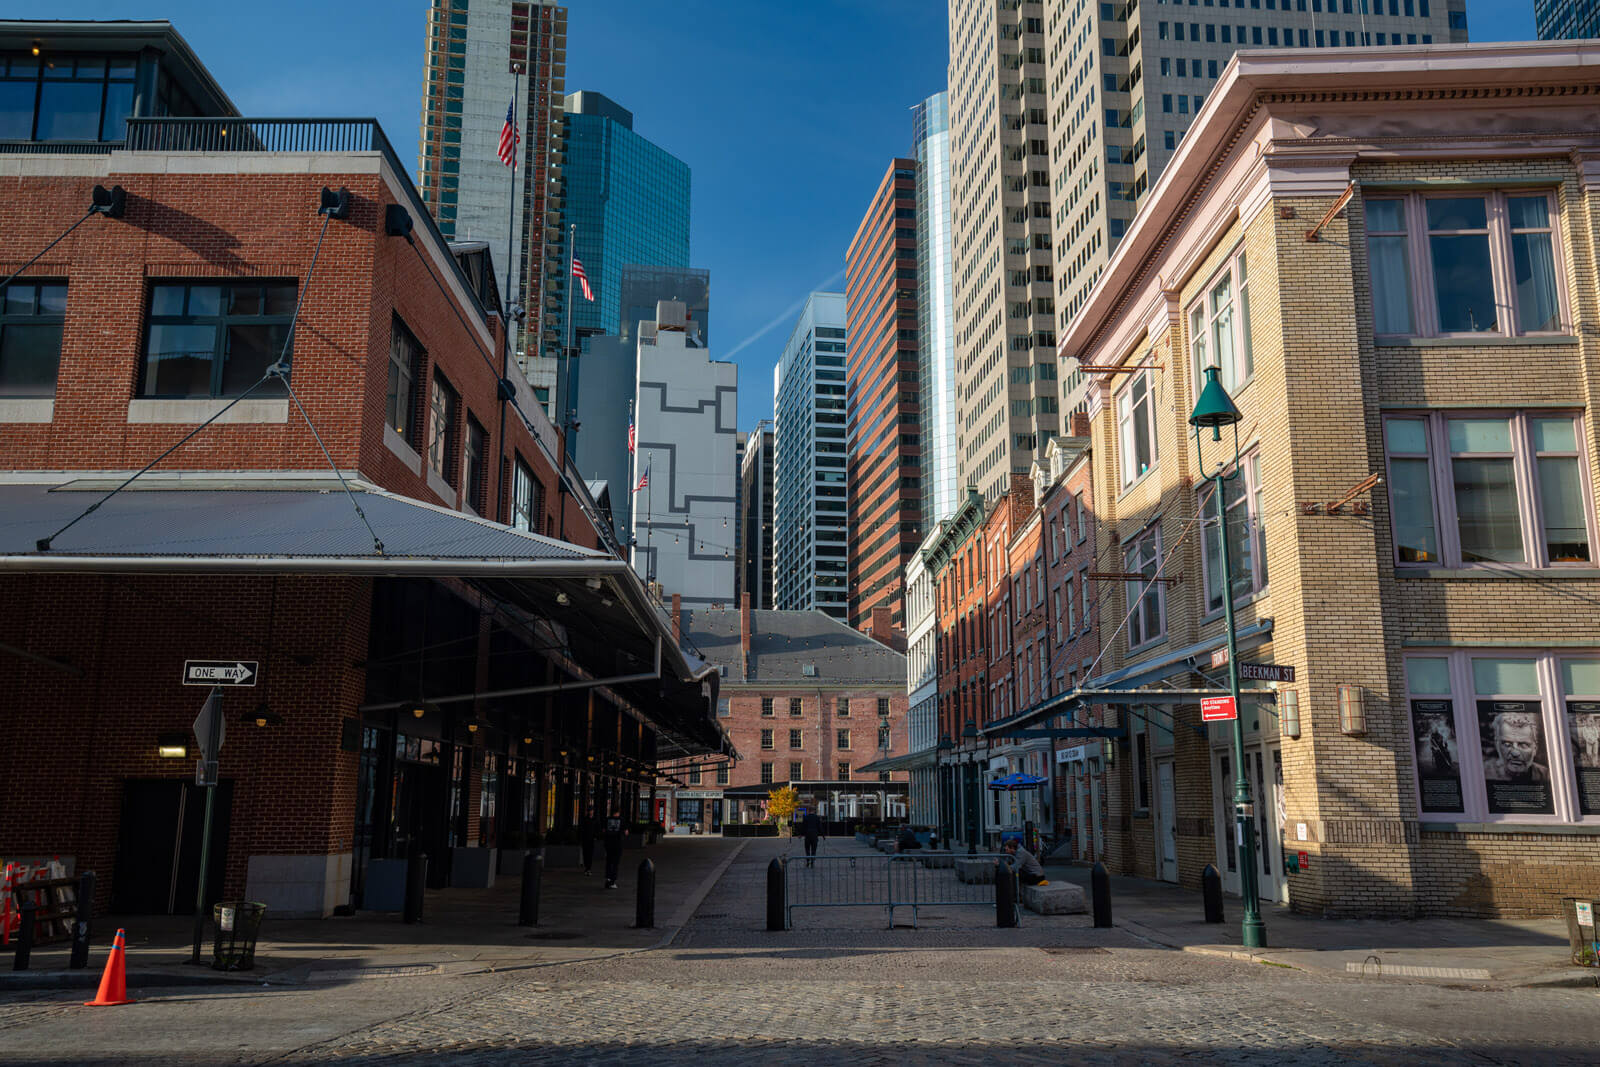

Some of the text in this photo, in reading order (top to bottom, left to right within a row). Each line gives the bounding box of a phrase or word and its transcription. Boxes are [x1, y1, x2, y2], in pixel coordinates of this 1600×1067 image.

[194, 668, 245, 678] ONE WAY
[1243, 665, 1293, 681] BEEKMAN ST
